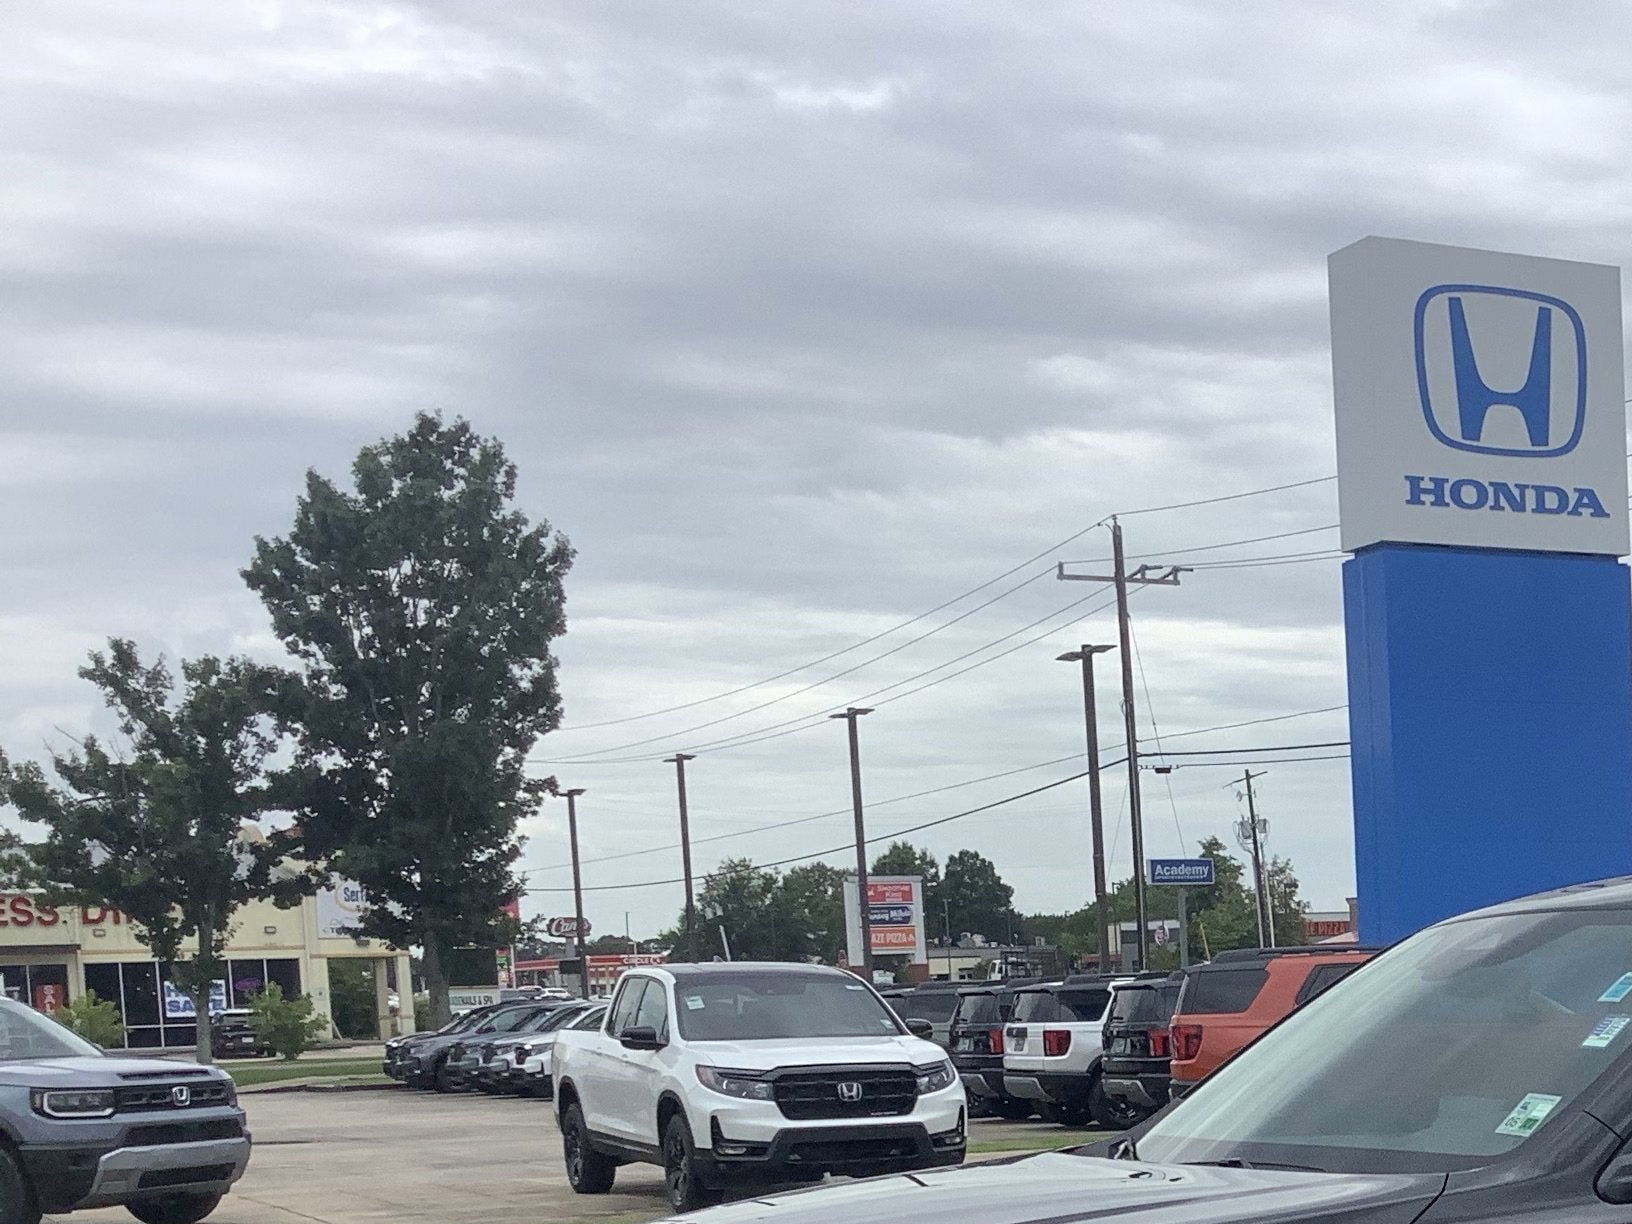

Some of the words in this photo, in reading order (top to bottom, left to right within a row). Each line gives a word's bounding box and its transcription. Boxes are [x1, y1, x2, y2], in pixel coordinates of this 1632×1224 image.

[1404, 475, 1611, 518] HONDA
[1155, 863, 1209, 878] Academy
[343, 886, 368, 902] Sert
[1318, 921, 1345, 935] PIZZA
[886, 932, 907, 944] PIZZA
